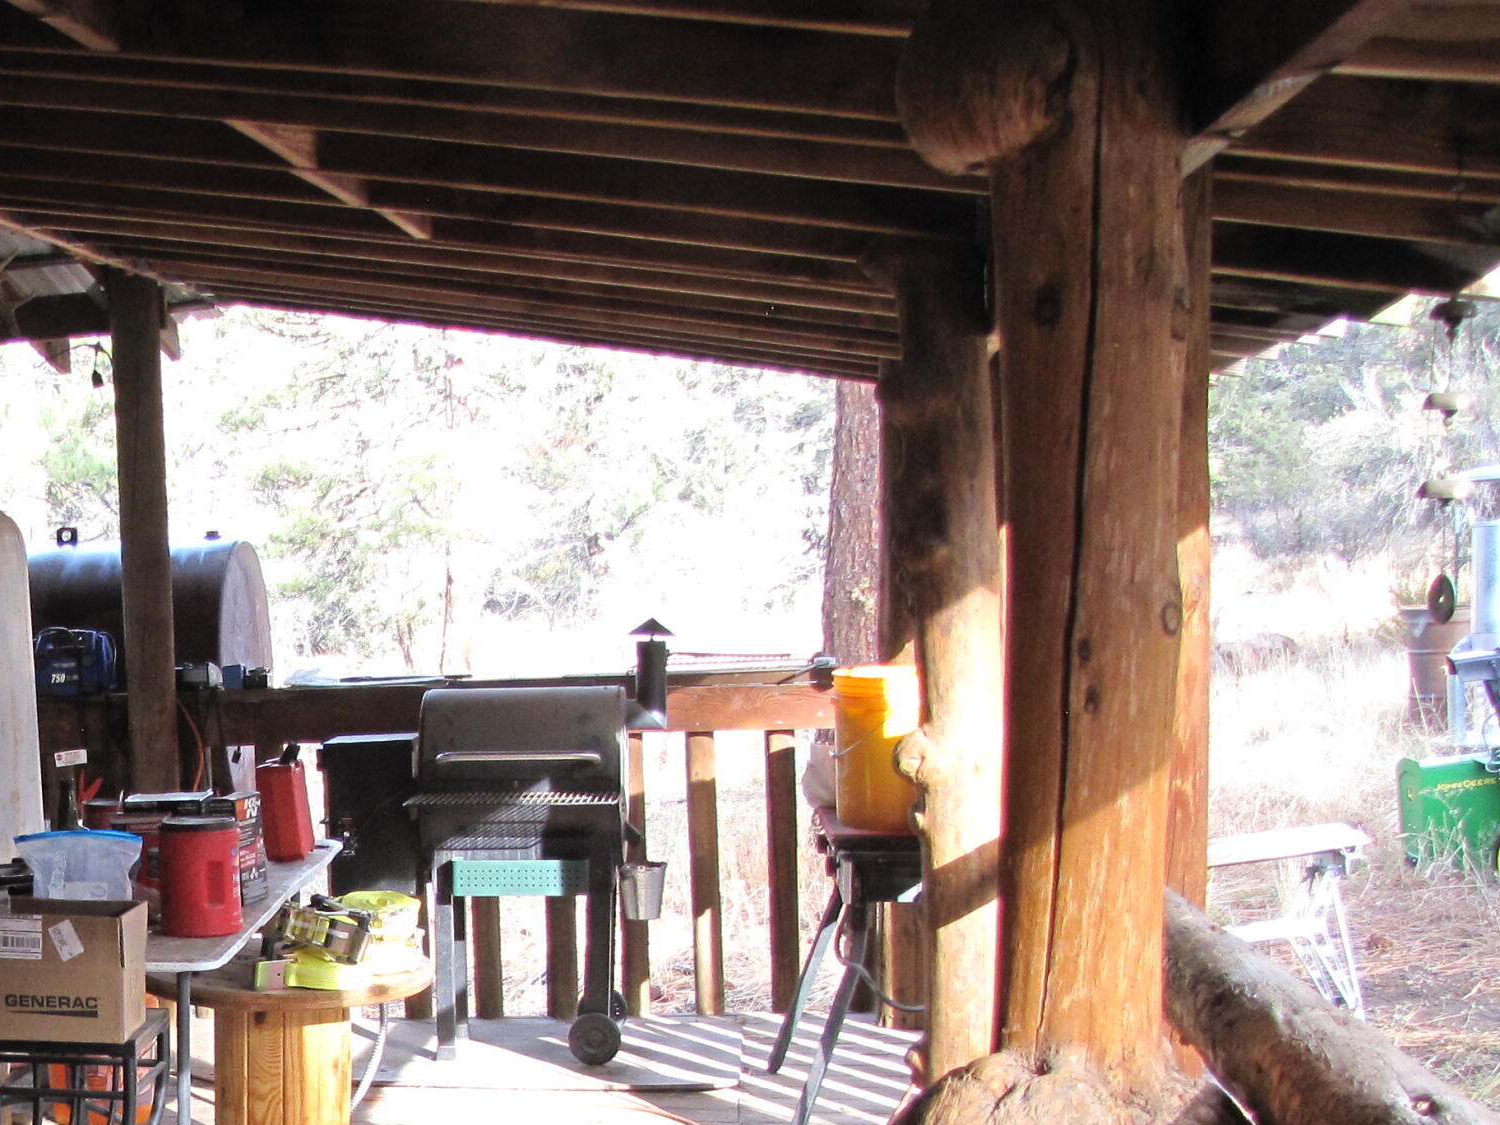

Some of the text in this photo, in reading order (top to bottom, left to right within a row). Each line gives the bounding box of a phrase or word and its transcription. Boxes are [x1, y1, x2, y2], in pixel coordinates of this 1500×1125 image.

[51, 673, 66, 684] 750
[1436, 777, 1498, 791] JOHN DEERE
[4, 993, 98, 1009] GENERAC
